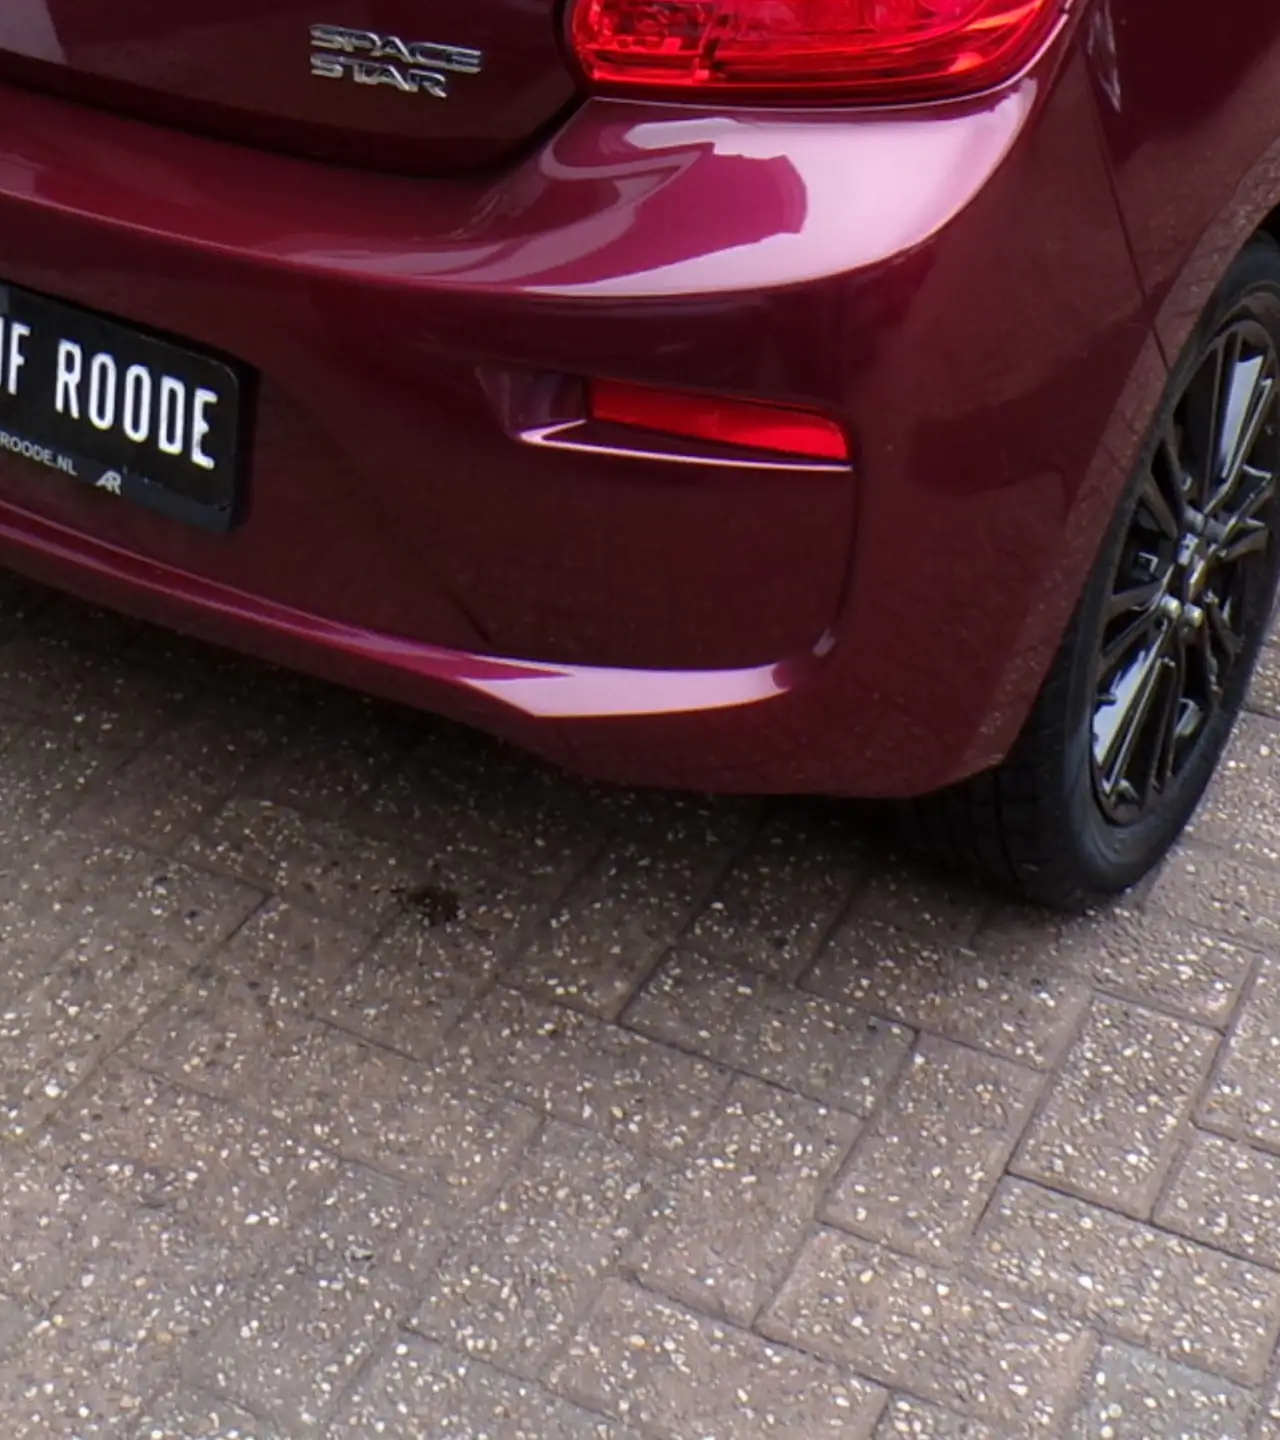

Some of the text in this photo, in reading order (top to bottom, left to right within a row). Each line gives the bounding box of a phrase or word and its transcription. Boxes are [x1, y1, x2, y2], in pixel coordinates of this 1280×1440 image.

[309, 23, 482, 75] SPACE
[309, 52, 448, 99] STAR
[55, 338, 219, 471] ROODE
